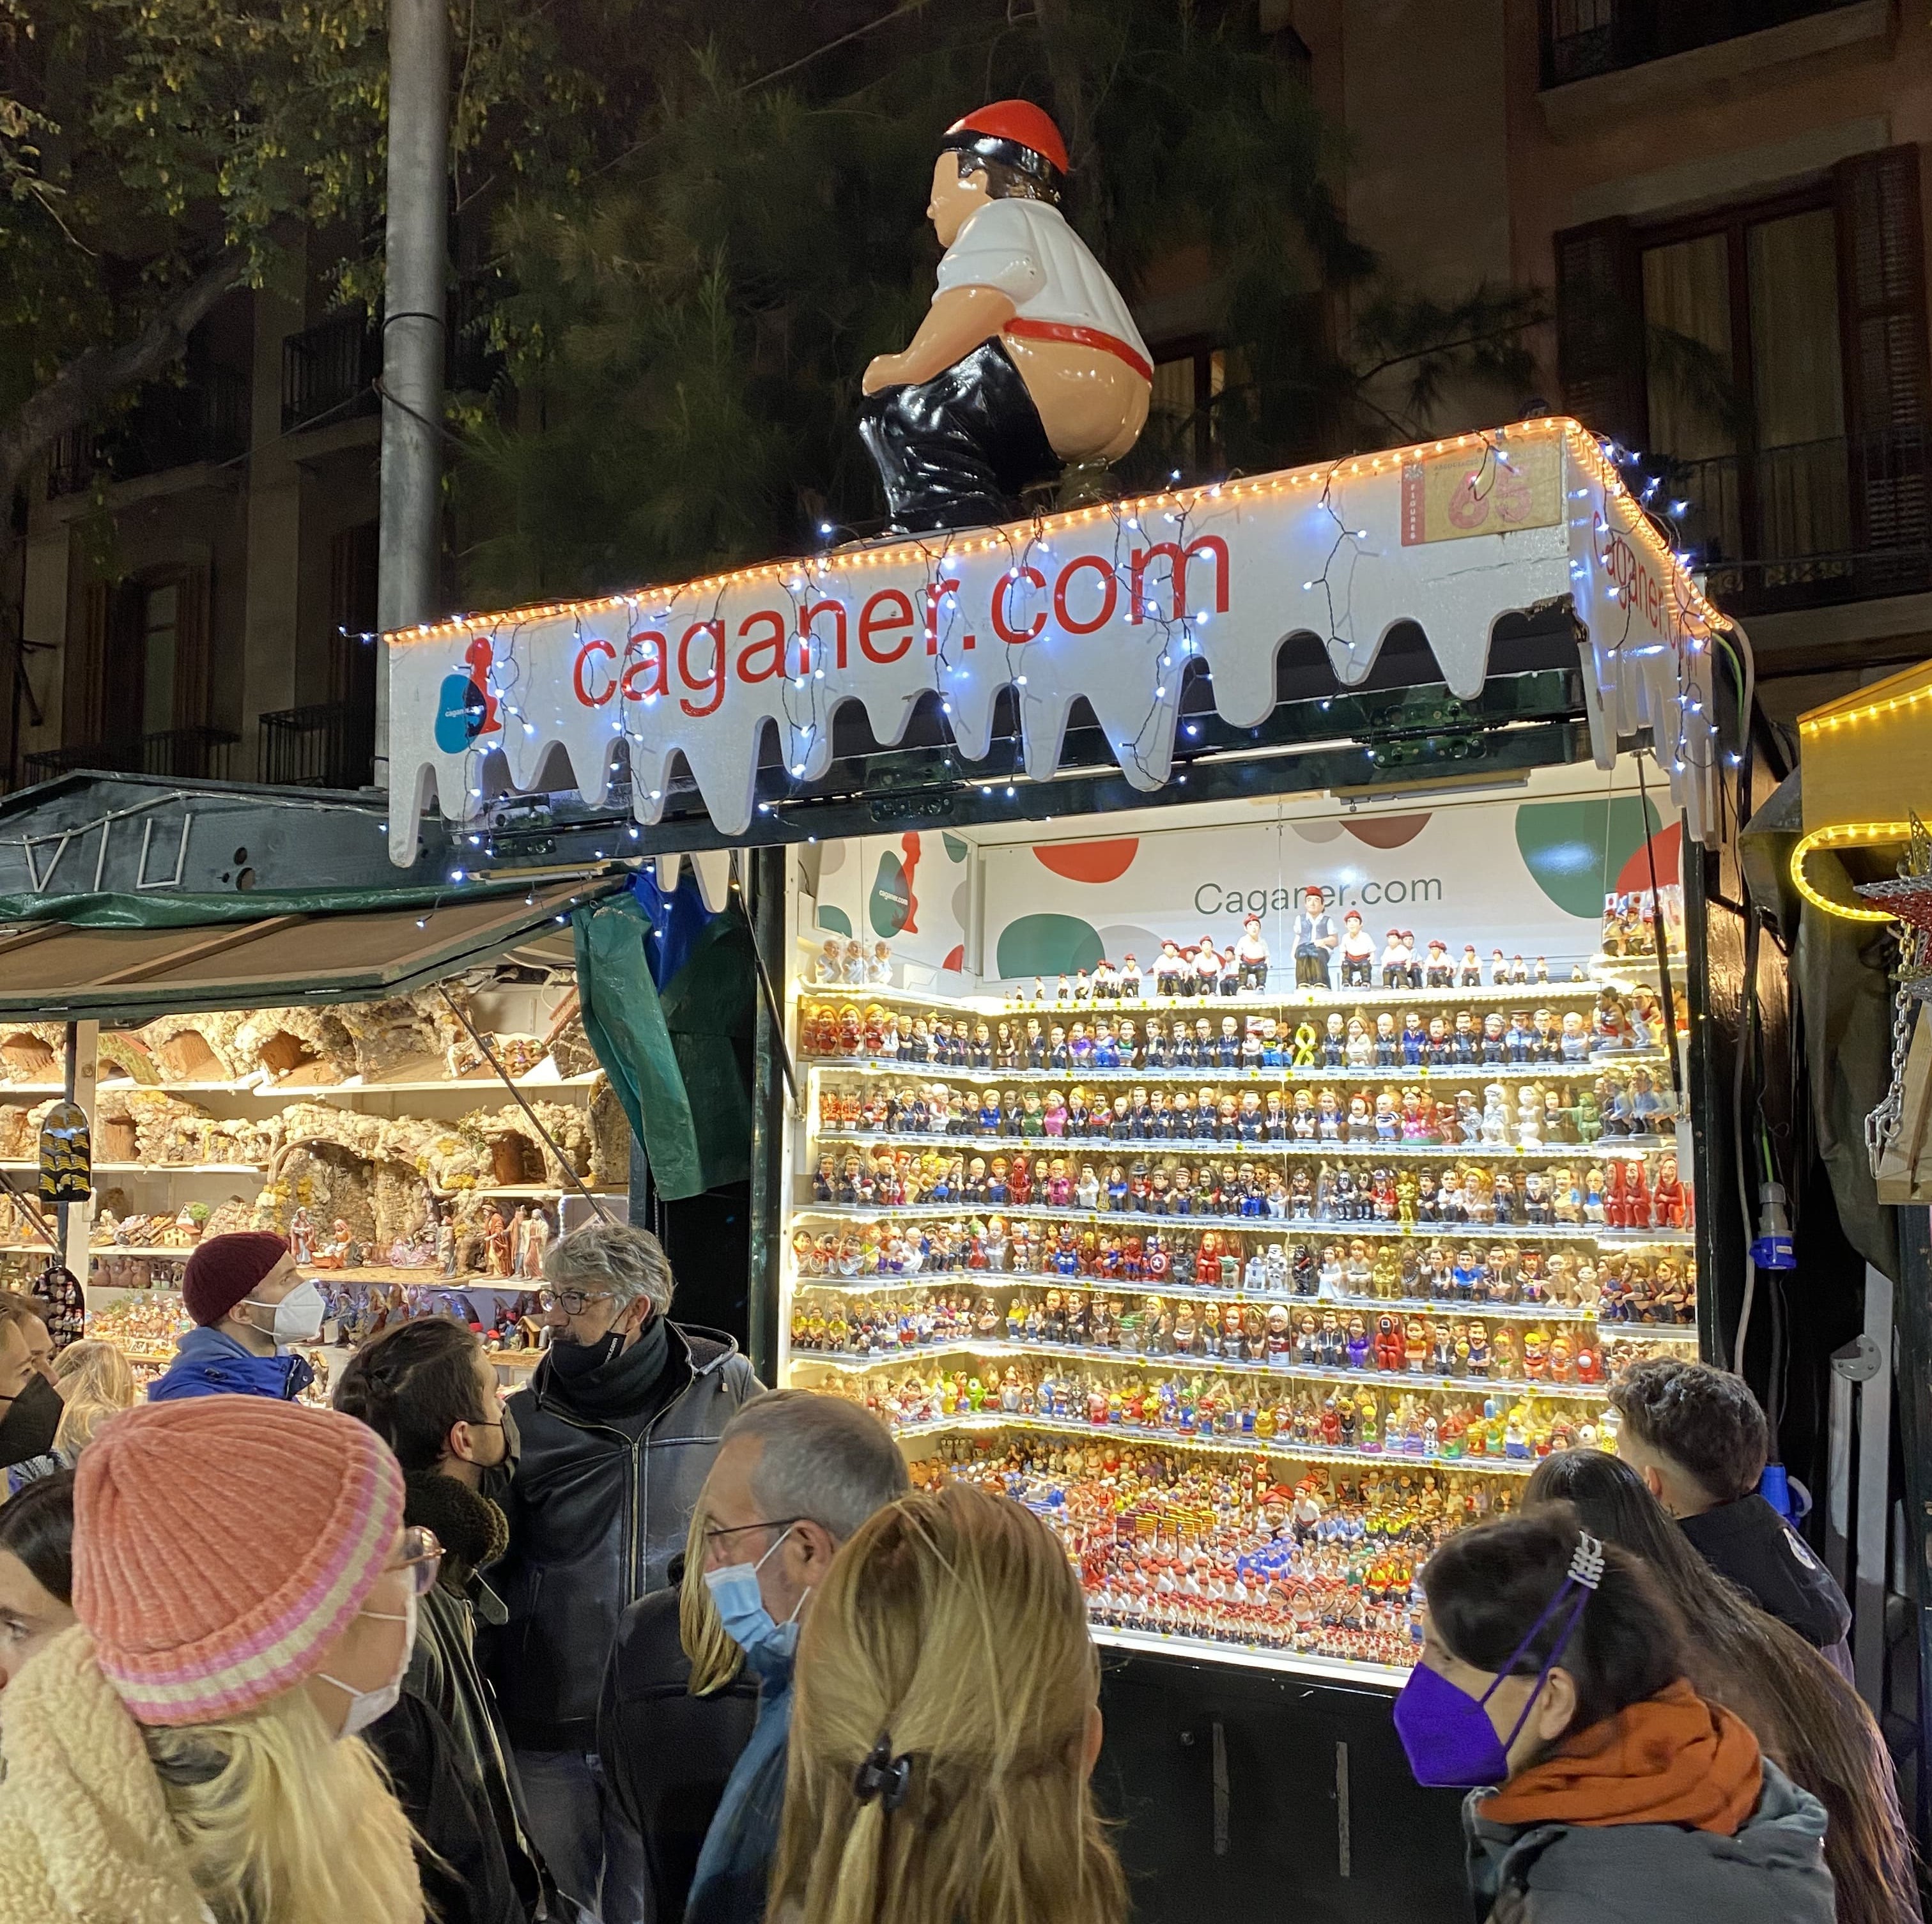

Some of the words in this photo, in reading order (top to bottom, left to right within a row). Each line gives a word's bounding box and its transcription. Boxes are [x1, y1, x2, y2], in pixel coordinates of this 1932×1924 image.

[1448, 464, 1533, 530] 65
[573, 534, 1232, 717] caganer.com
[1194, 877, 1442, 919] Caganer.com
